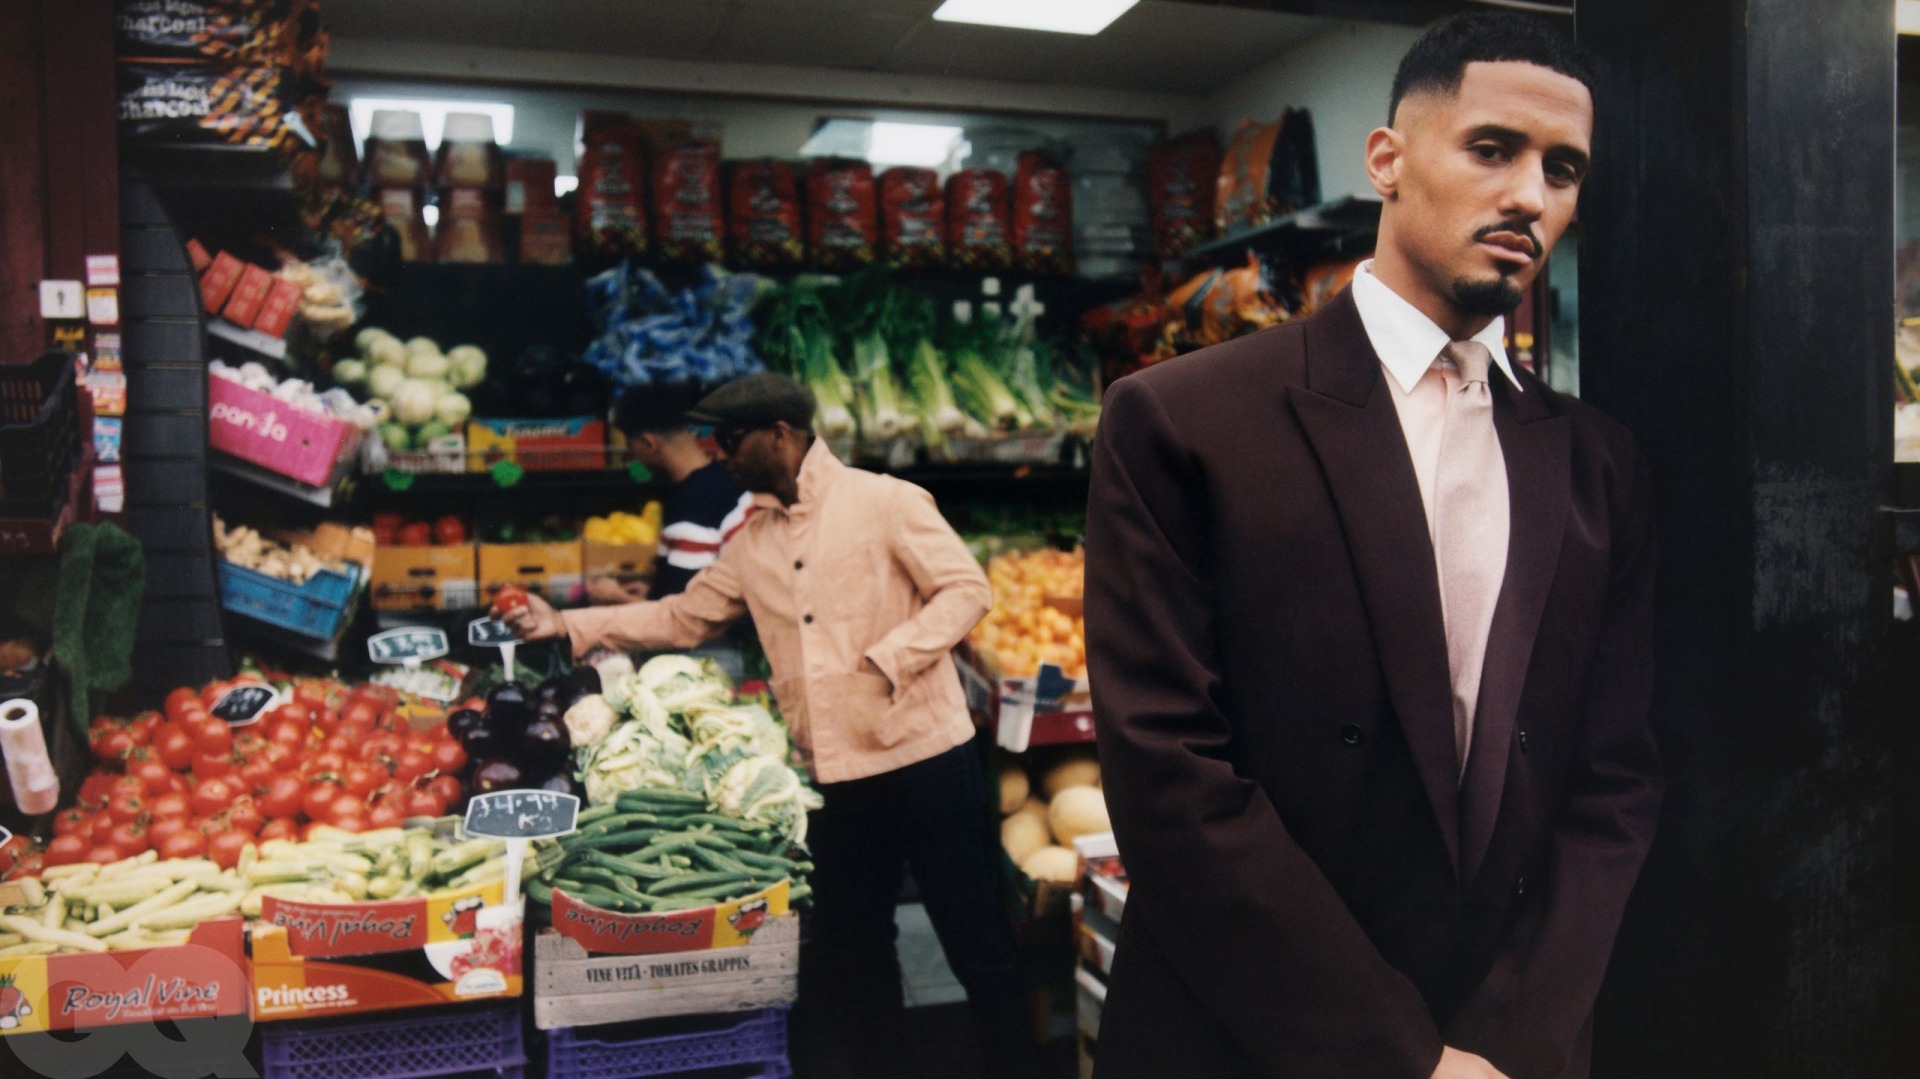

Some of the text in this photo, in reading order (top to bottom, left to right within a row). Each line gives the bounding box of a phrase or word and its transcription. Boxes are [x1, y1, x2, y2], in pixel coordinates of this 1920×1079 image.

[617, 916, 703, 942] Royal
[586, 967, 613, 983] VINE
[649, 960, 698, 979] TOMATES
[701, 956, 750, 974] GRAPPES
[61, 973, 219, 1020] Royal Vine
[257, 983, 349, 1007] Princess
